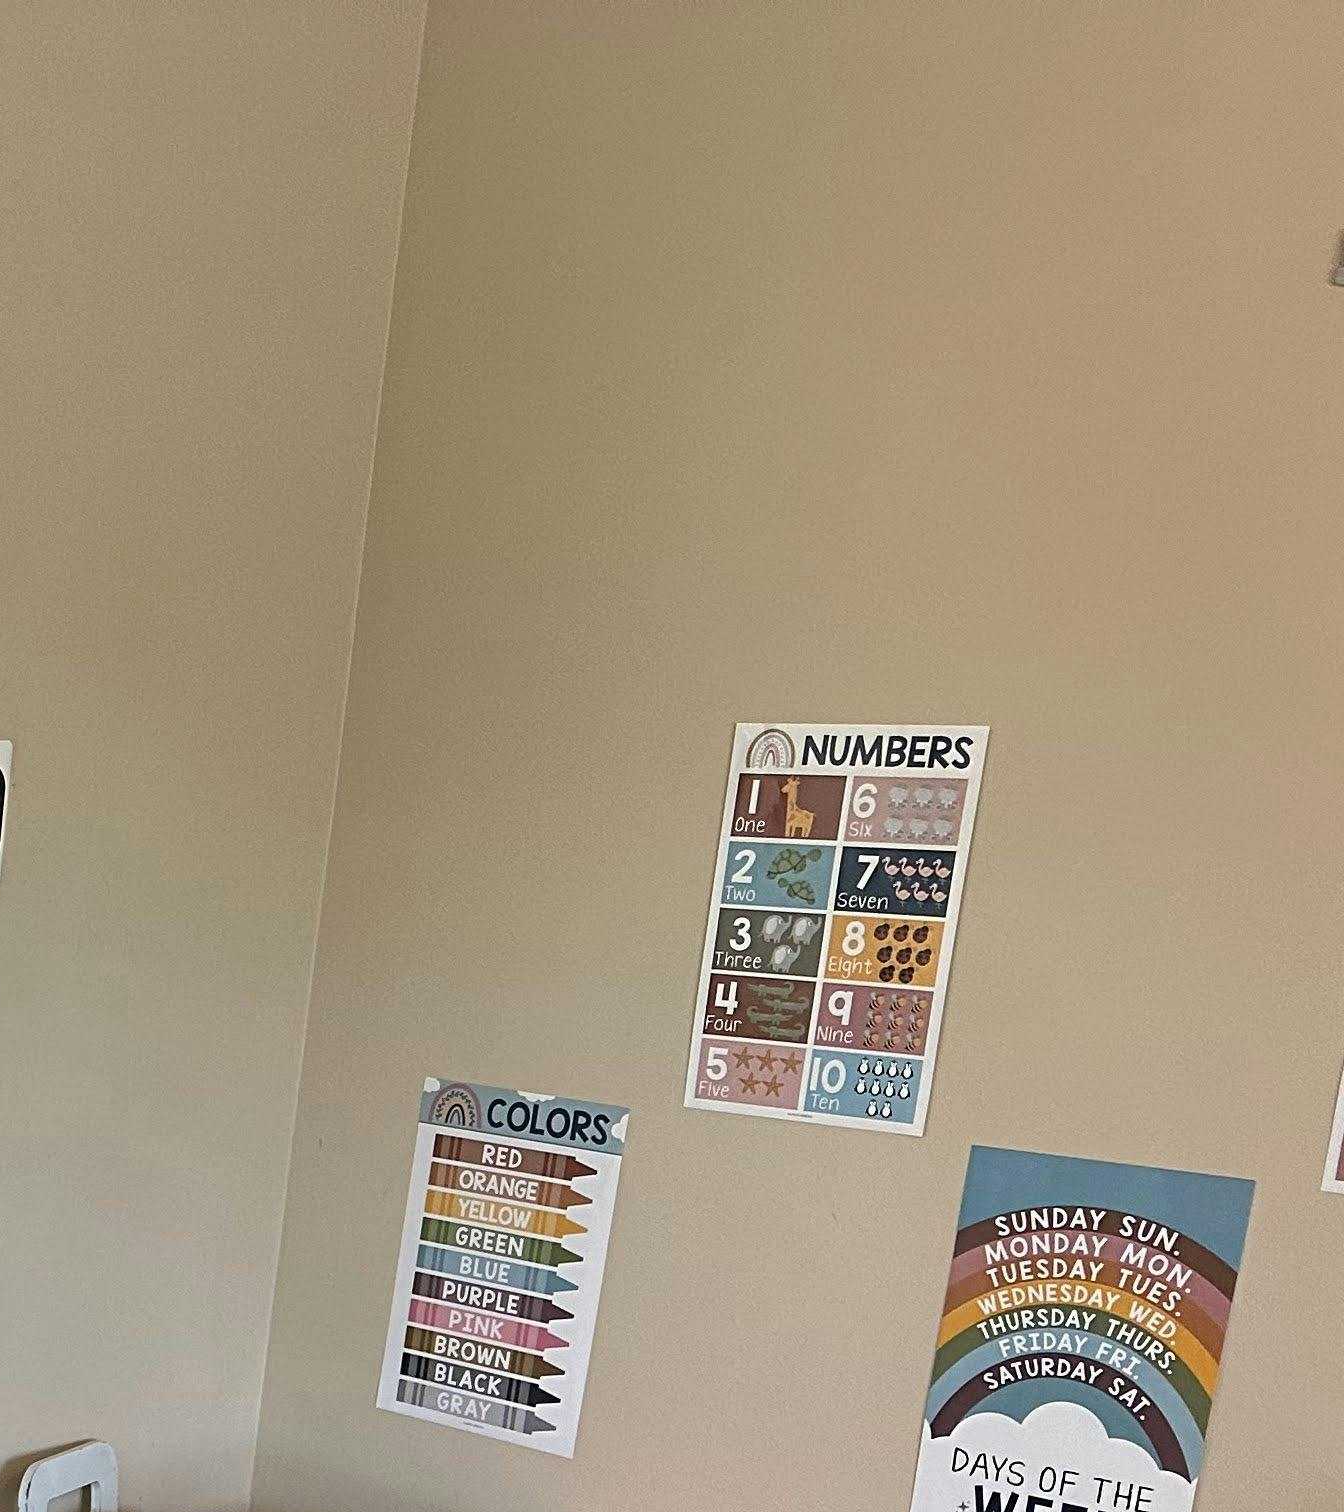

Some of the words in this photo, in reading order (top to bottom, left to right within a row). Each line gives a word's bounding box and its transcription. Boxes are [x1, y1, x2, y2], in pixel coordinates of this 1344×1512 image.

[801, 734, 974, 769] NUMBERS
[749, 779, 761, 814] 1
[853, 783, 878, 818] 6
[734, 816, 766, 834] One
[730, 849, 757, 885] 2
[857, 855, 880, 890] 7
[724, 886, 755, 903] Two
[836, 892, 889, 910] Seven
[729, 917, 752, 951] 3
[842, 921, 866, 956] 8
[714, 951, 763, 970] Three
[714, 980, 739, 1015] 4
[828, 990, 854, 1026] 9
[704, 1014, 743, 1032] Four
[706, 1047, 729, 1081] 5
[810, 1057, 847, 1094] 10
[812, 1093, 840, 1111] Ten
[487, 1098, 610, 1145] COLORS
[481, 1144, 522, 1168] RED
[459, 1170, 539, 1201] ORANGE
[457, 1197, 532, 1229] YELLOW
[455, 1226, 524, 1257] GREEN
[994, 1207, 1108, 1237] SUNDAY
[1119, 1215, 1180, 1256] SUN.
[459, 1255, 511, 1284] BLUE
[984, 1233, 1108, 1266] MONDAY
[1119, 1243, 1192, 1293] MON.
[442, 1282, 519, 1315] PURPLE
[986, 1258, 1105, 1287] TUESDAY
[1118, 1269, 1182, 1317] TUES.
[448, 1310, 503, 1339] PINK
[976, 1284, 1121, 1315] WEDNESDAY
[1129, 1305, 1178, 1345] WED.
[434, 1336, 511, 1369] BROWN
[976, 1308, 1096, 1340] THURSDAY
[1106, 1318, 1177, 1375] THURS.
[999, 1333, 1088, 1358] FRIDAY
[1096, 1344, 1143, 1380] FRI.
[434, 1363, 501, 1396] BLACK
[983, 1357, 1103, 1390] SATURDAY
[1108, 1377, 1151, 1420] SAT.
[437, 1392, 491, 1420] GRAY
[951, 1447, 1025, 1487] DAYS
[1039, 1466, 1080, 1496] OF
